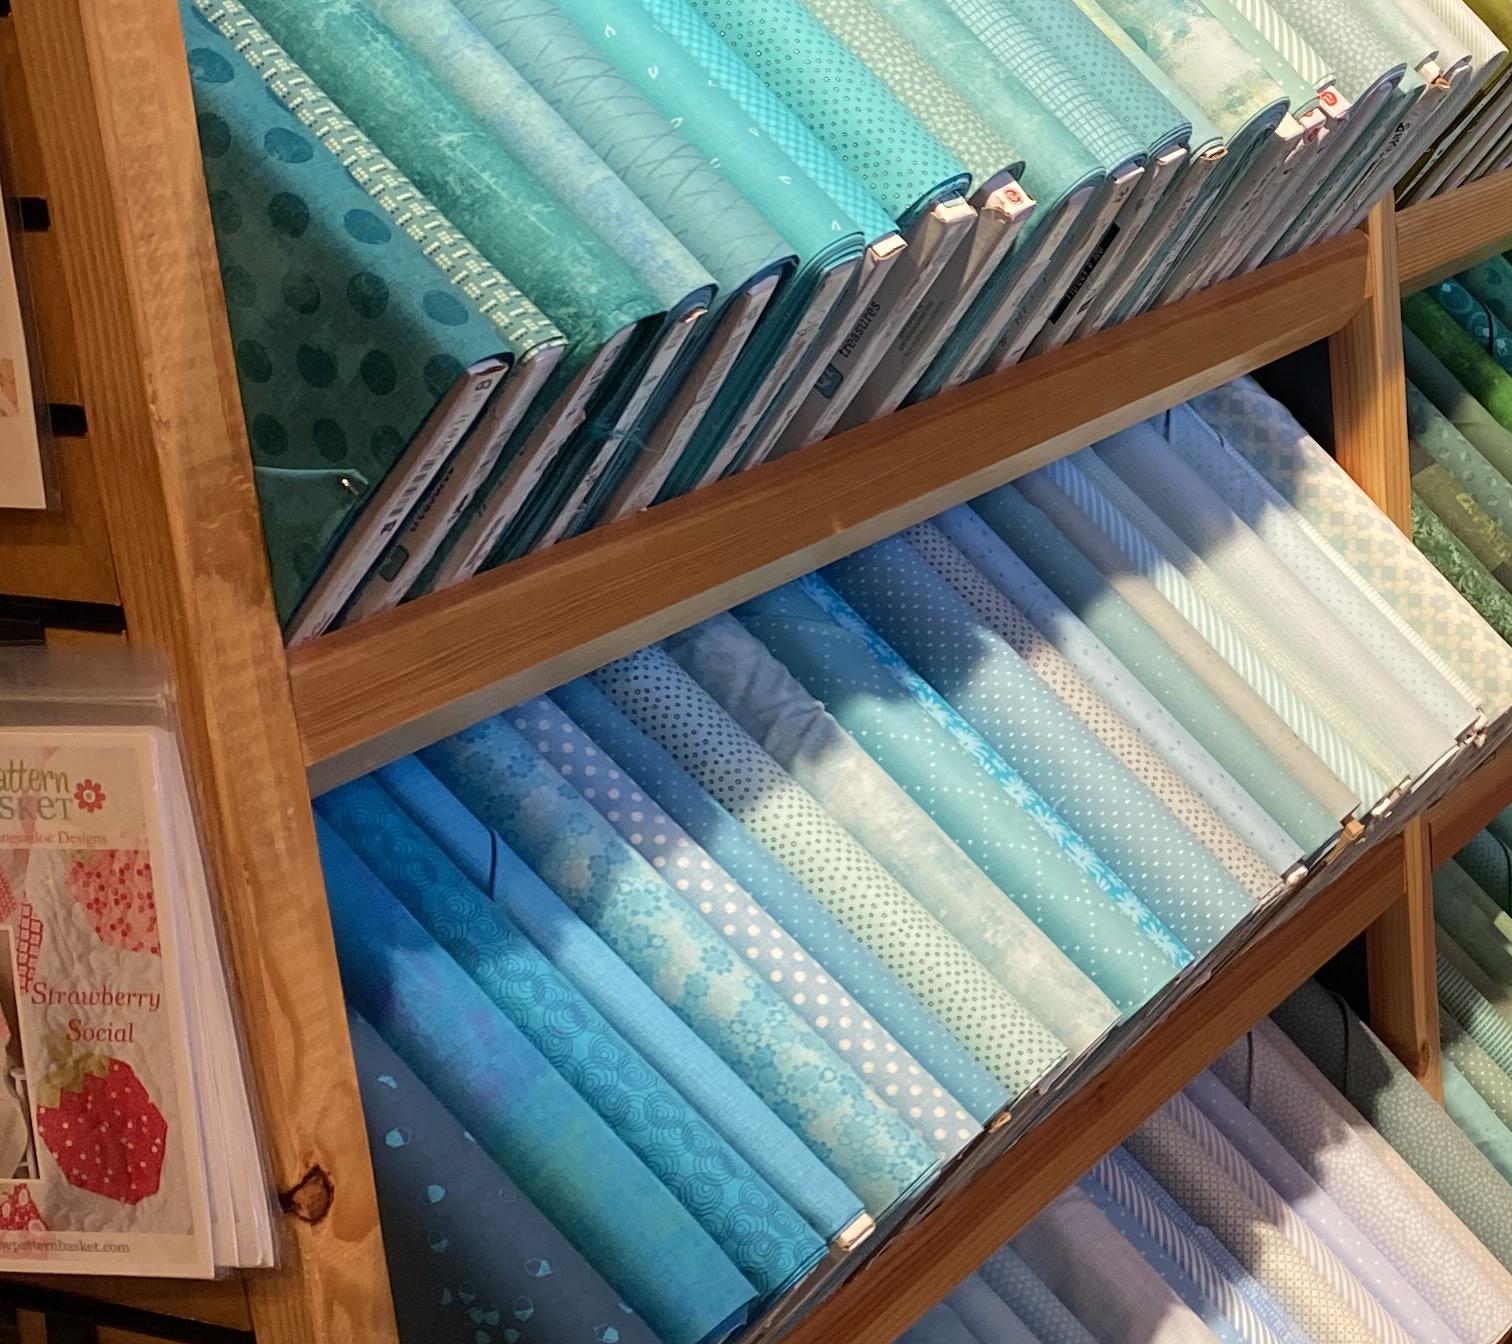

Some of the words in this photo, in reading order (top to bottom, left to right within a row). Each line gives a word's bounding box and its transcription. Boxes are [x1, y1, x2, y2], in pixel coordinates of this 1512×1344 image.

[839, 300, 881, 359] treasures
[31, 982, 161, 1012] Strawberry
[67, 1017, 134, 1043] Social
